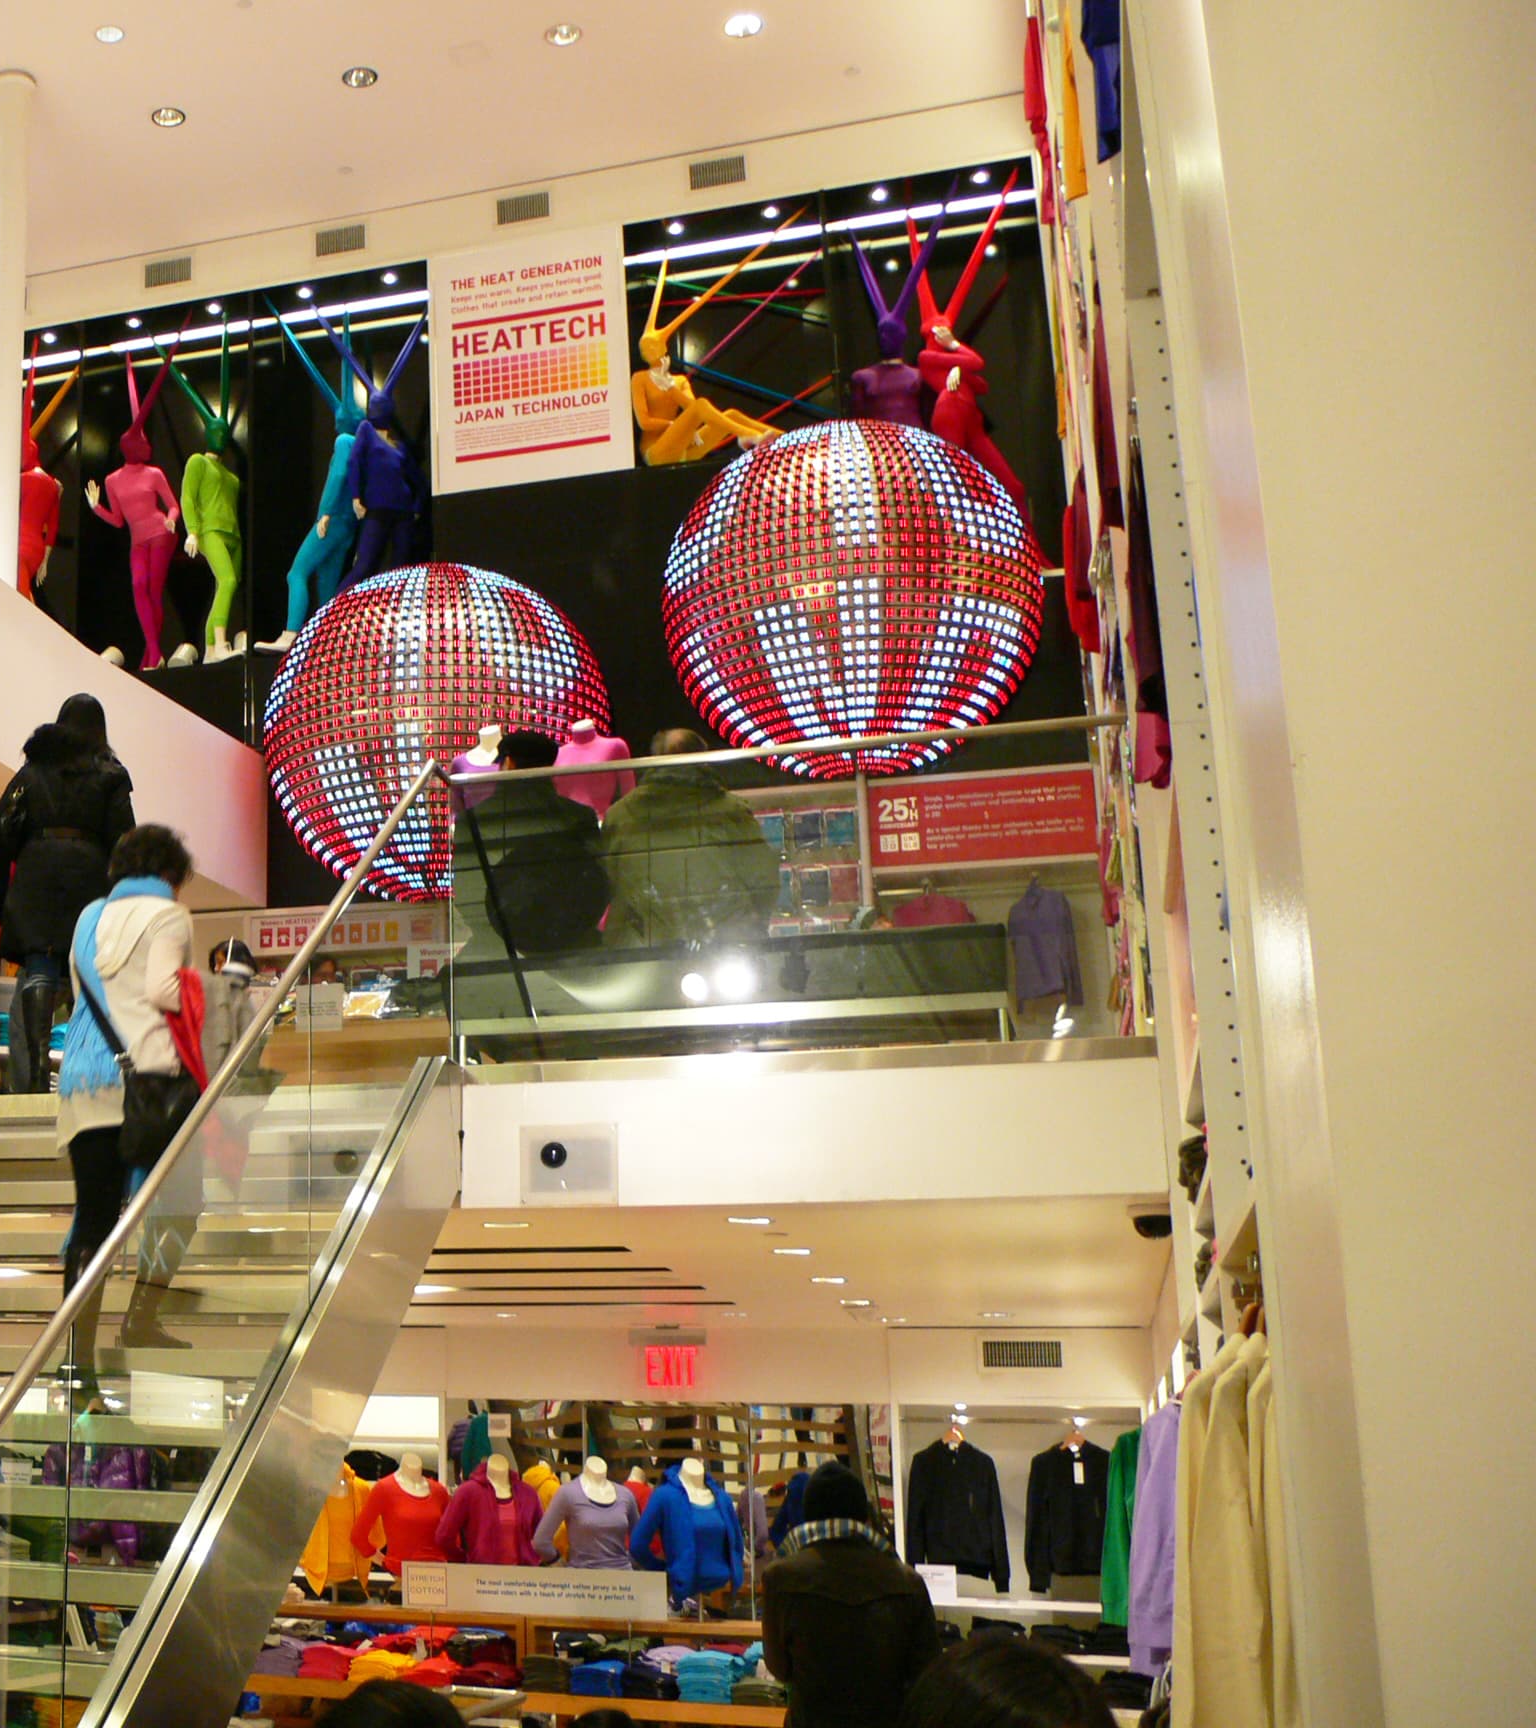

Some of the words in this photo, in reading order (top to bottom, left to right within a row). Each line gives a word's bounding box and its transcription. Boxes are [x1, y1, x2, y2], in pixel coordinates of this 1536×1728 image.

[451, 277, 475, 291] THE
[480, 270, 515, 287] HEAT
[520, 256, 602, 280] GENERATION
[452, 311, 607, 359] HEATTECH
[454, 406, 505, 425] JAPAN
[512, 389, 608, 417] TECHNOLOGY
[646, 1345, 697, 1387] EXIT
[410, 1586, 444, 1594] COTTON
